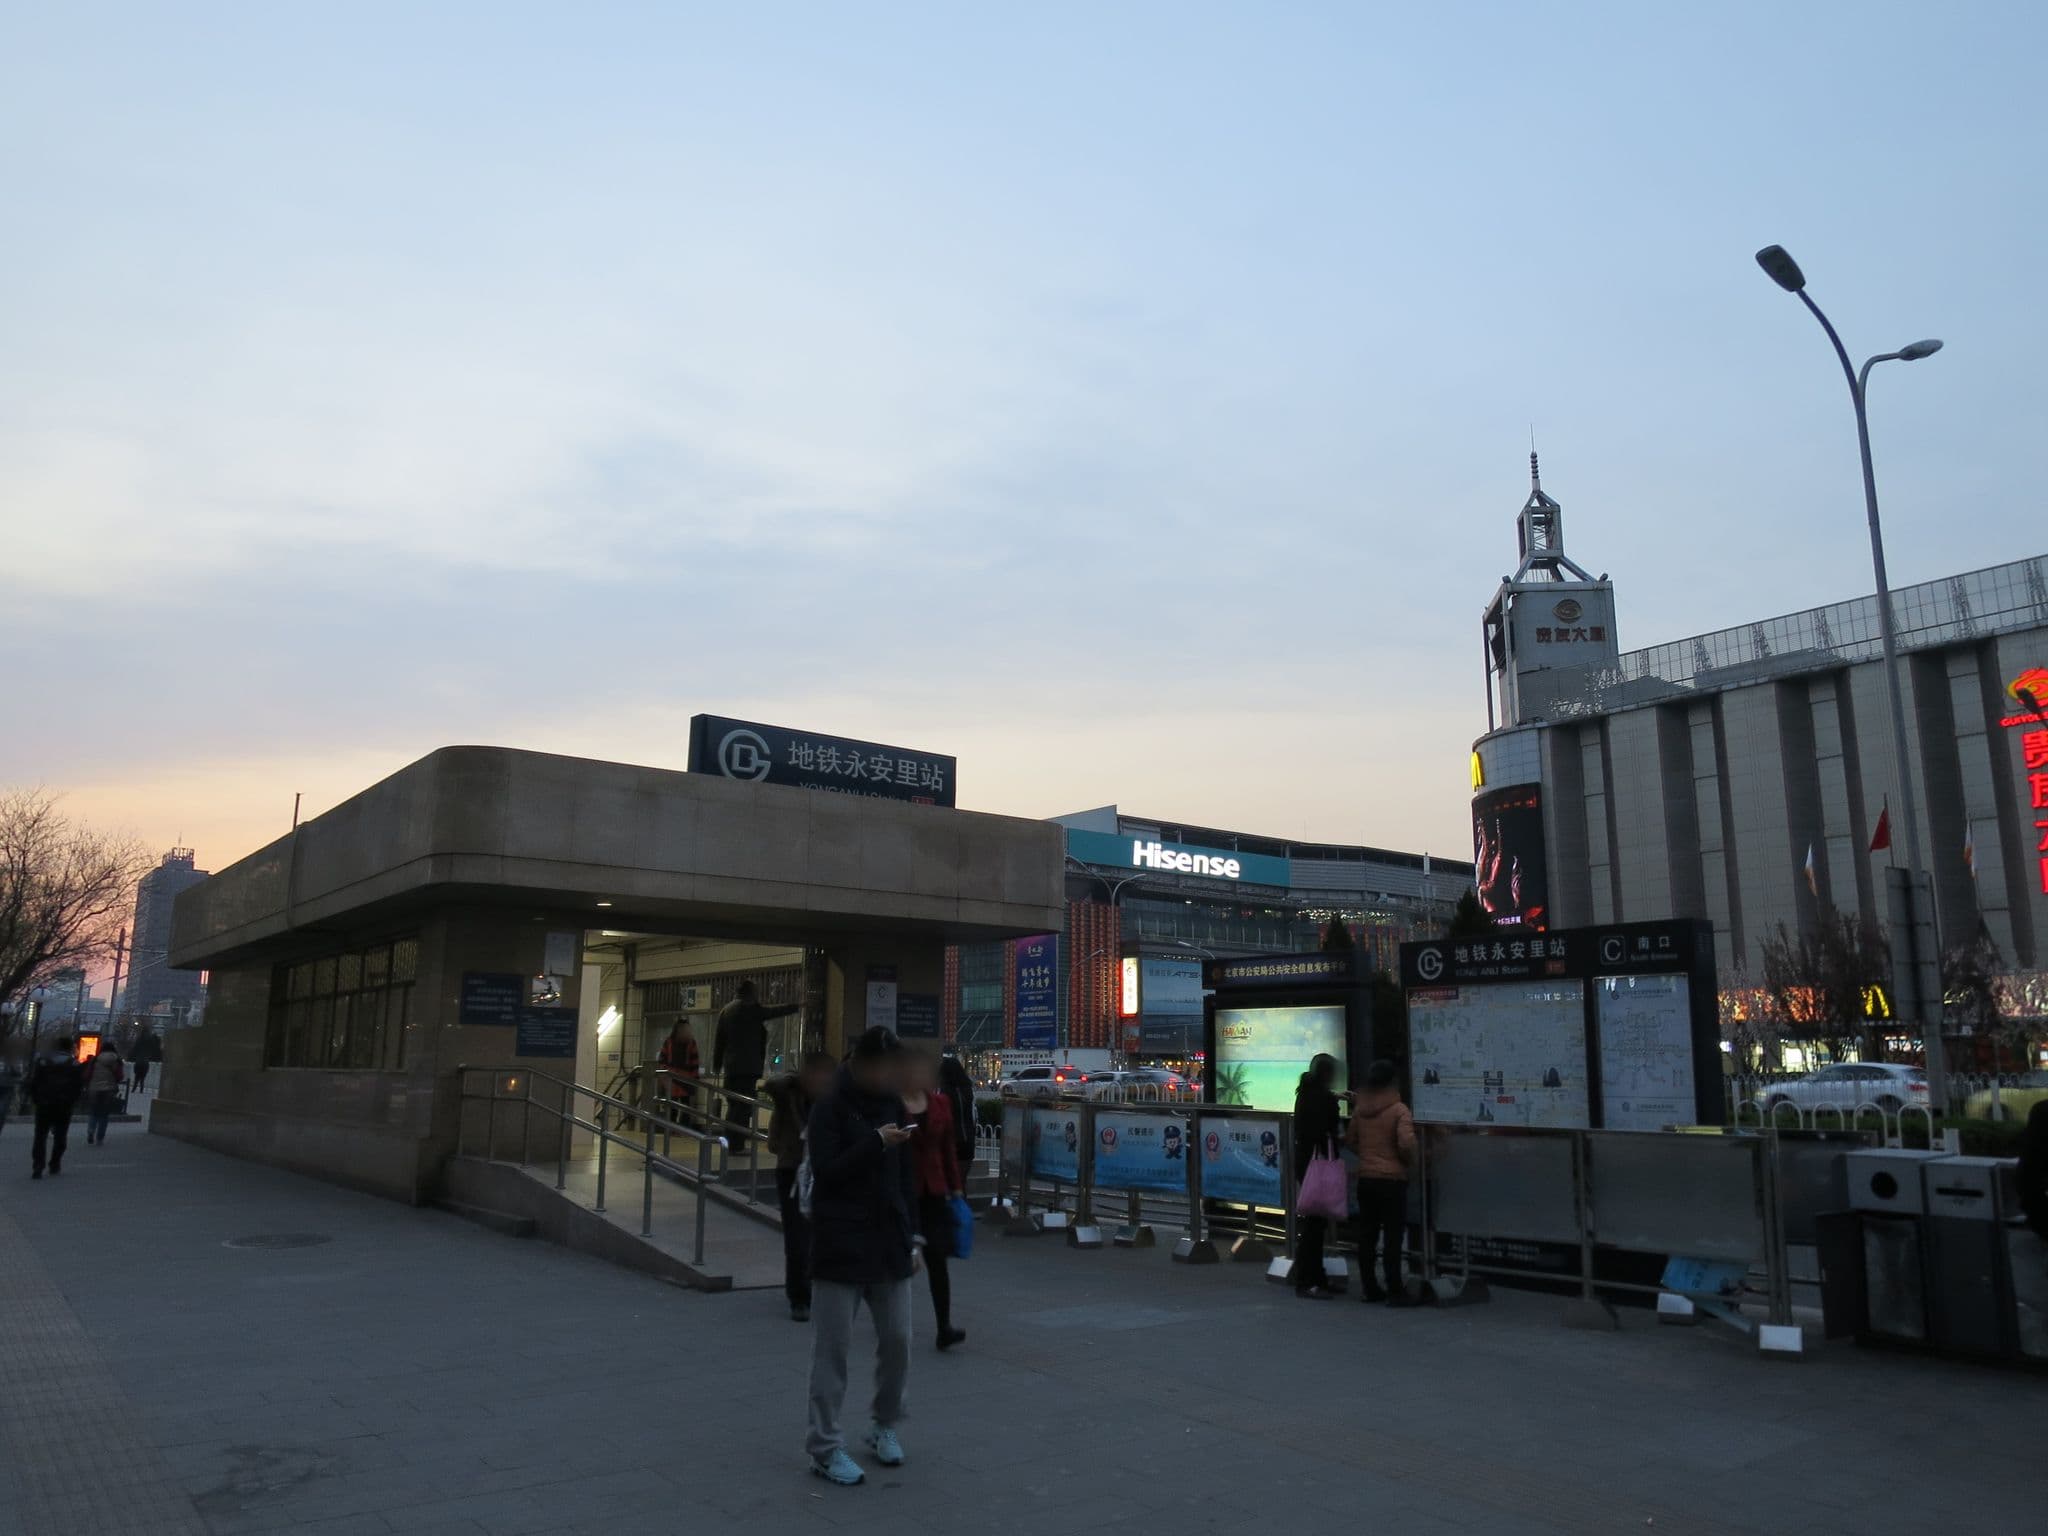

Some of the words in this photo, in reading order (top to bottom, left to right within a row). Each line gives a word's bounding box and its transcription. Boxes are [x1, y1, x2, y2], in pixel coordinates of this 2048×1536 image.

[788, 740, 944, 792] 地铁永安里站
[1132, 840, 1241, 878] Hisense
[1455, 937, 1566, 963] 地铁永安里站
